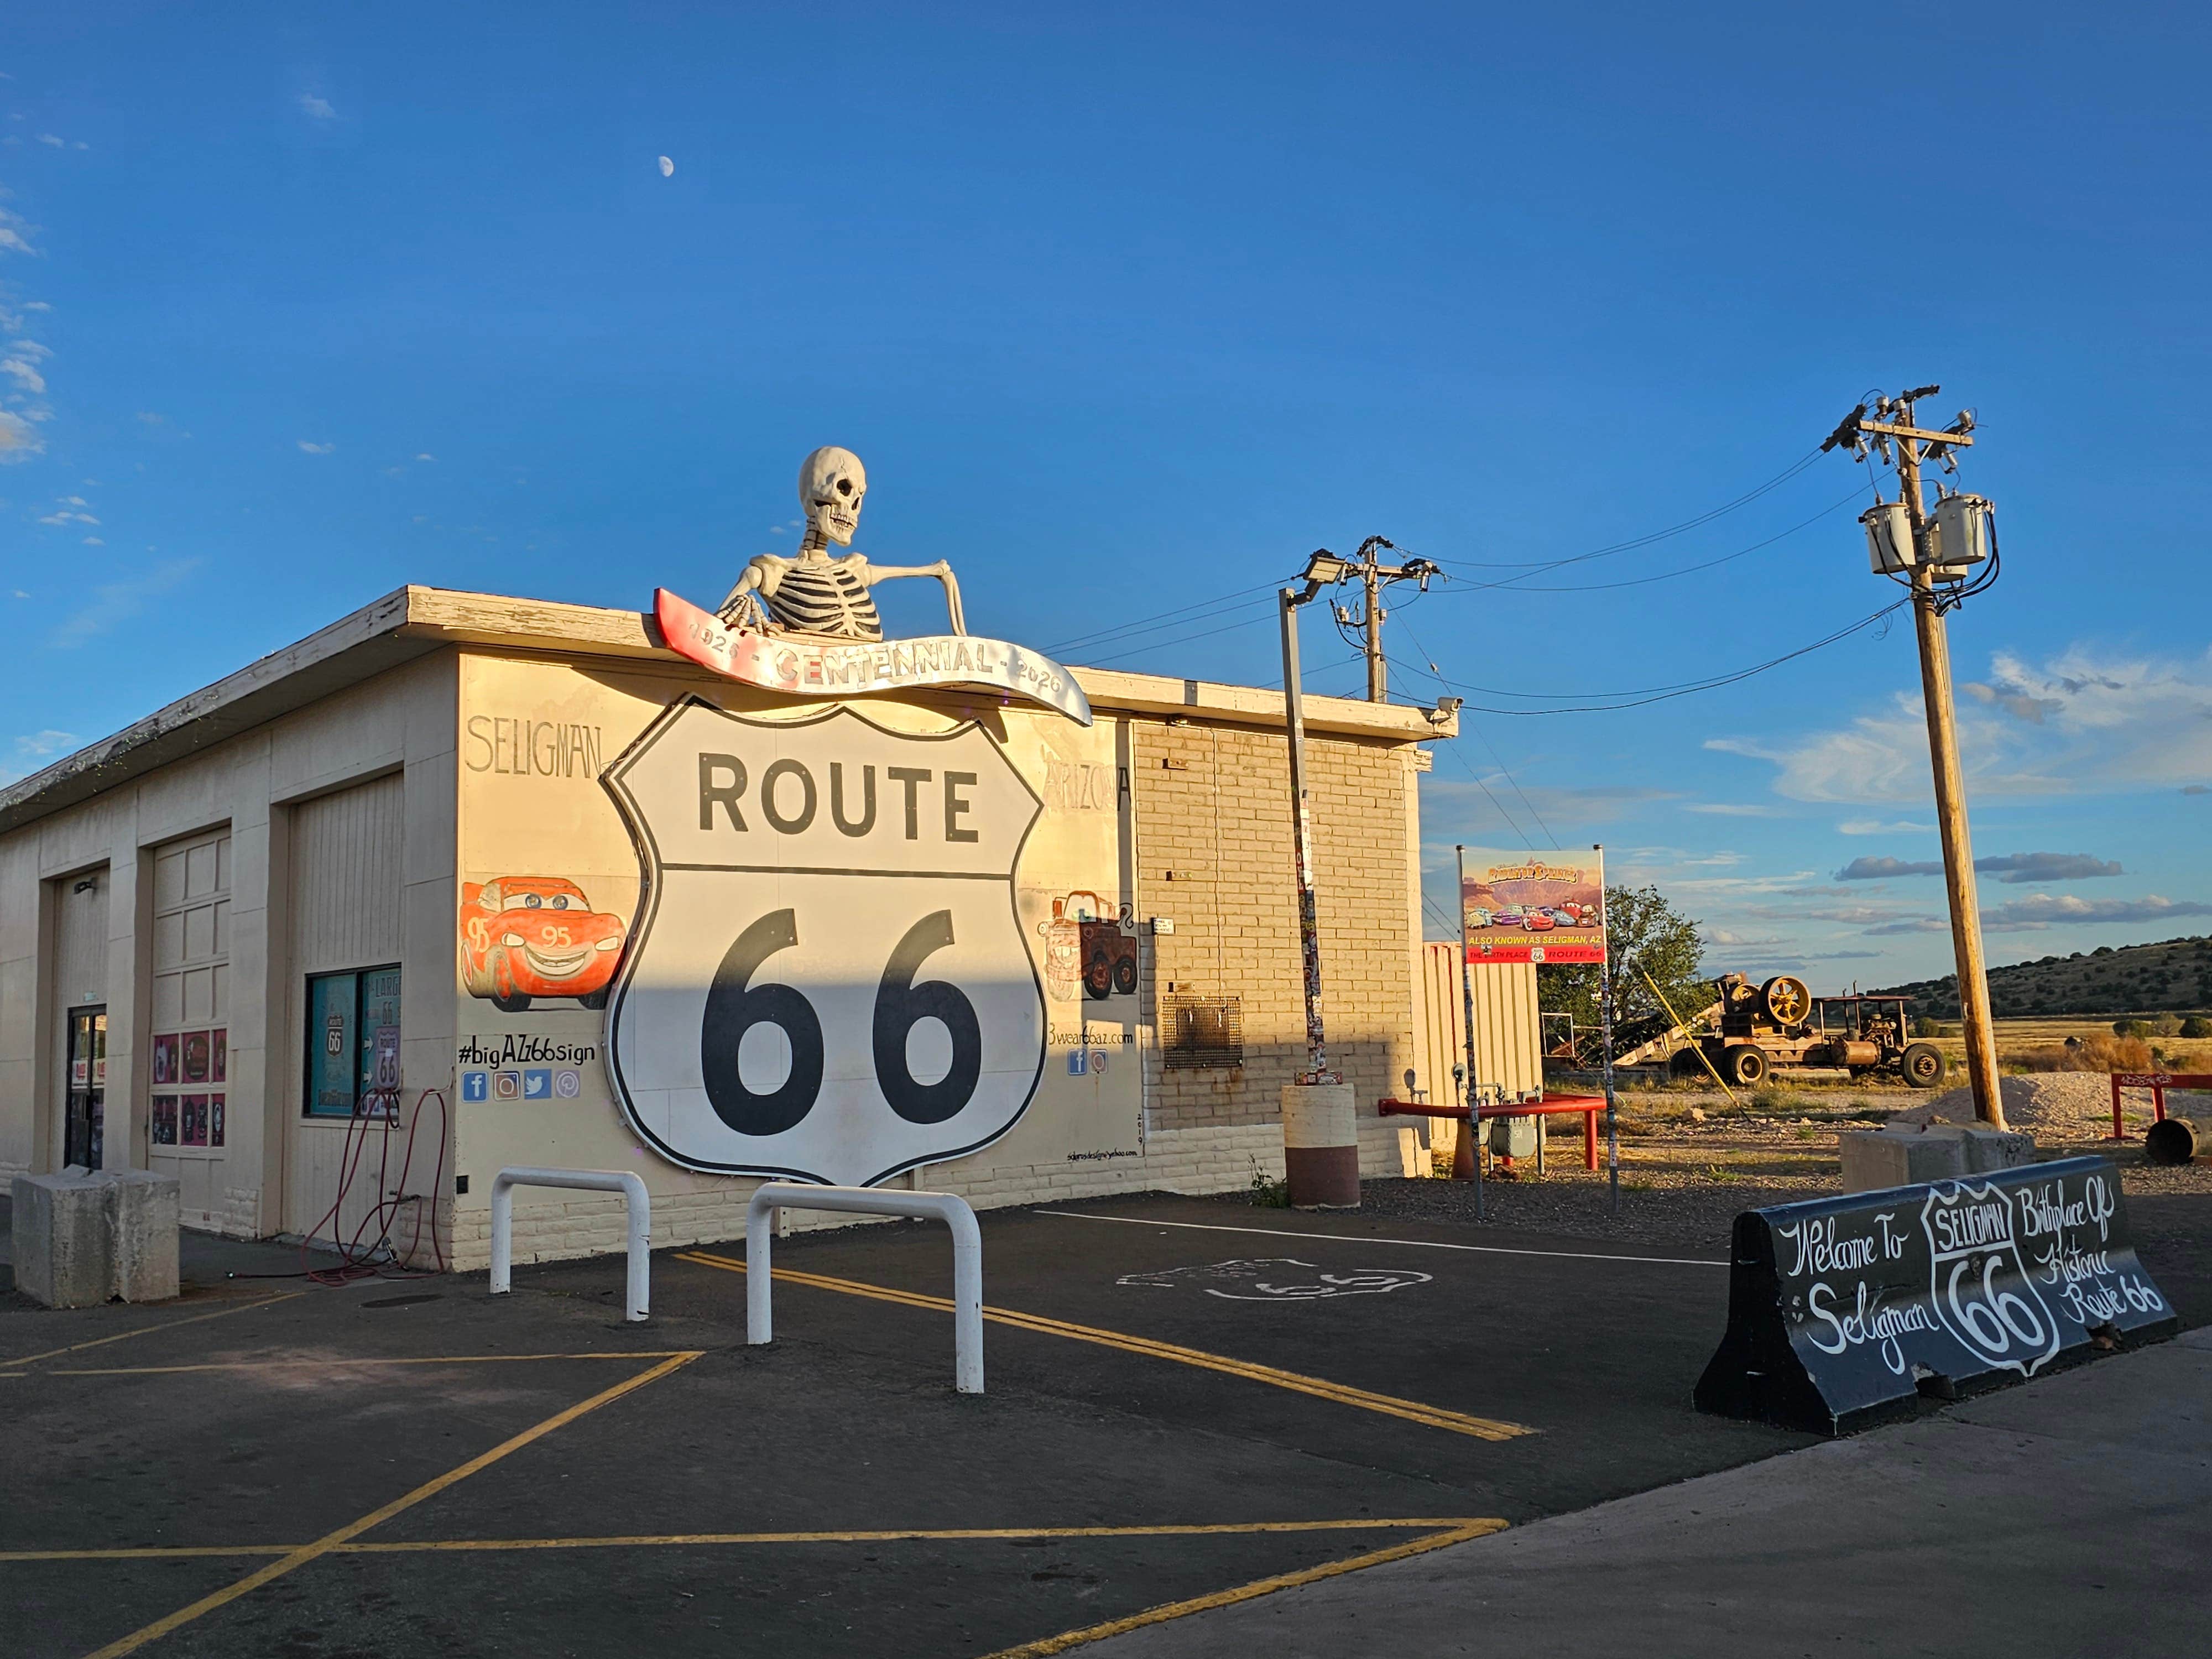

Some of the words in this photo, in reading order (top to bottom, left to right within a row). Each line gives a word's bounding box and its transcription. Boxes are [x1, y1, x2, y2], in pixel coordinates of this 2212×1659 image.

[690, 624, 739, 659] 1926
[776, 641, 994, 689] CENTENNIAL
[1018, 658, 1062, 692] 2026
[465, 715, 602, 778] SELIGMAN
[699, 753, 978, 842] ROUTE
[467, 917, 490, 953] 95
[541, 926, 572, 948] 95
[1542, 935, 1588, 945] SELIGMAN,
[1589, 935, 1601, 943] AZ
[329, 1031, 341, 1052] 66
[701, 908, 982, 1136] 66
[380, 1055, 395, 1083] 66
[1936, 1203, 2007, 1251] SELIGMAN
[2086, 1176, 2114, 1242] Of
[1778, 1217, 1878, 1276] Welcome
[1874, 1213, 1911, 1258] To
[1807, 1281, 1939, 1375] Seligman
[1948, 1255, 2045, 1353] 66
[2058, 1275, 2127, 1324] Route
[2119, 1274, 2163, 1312] 66
